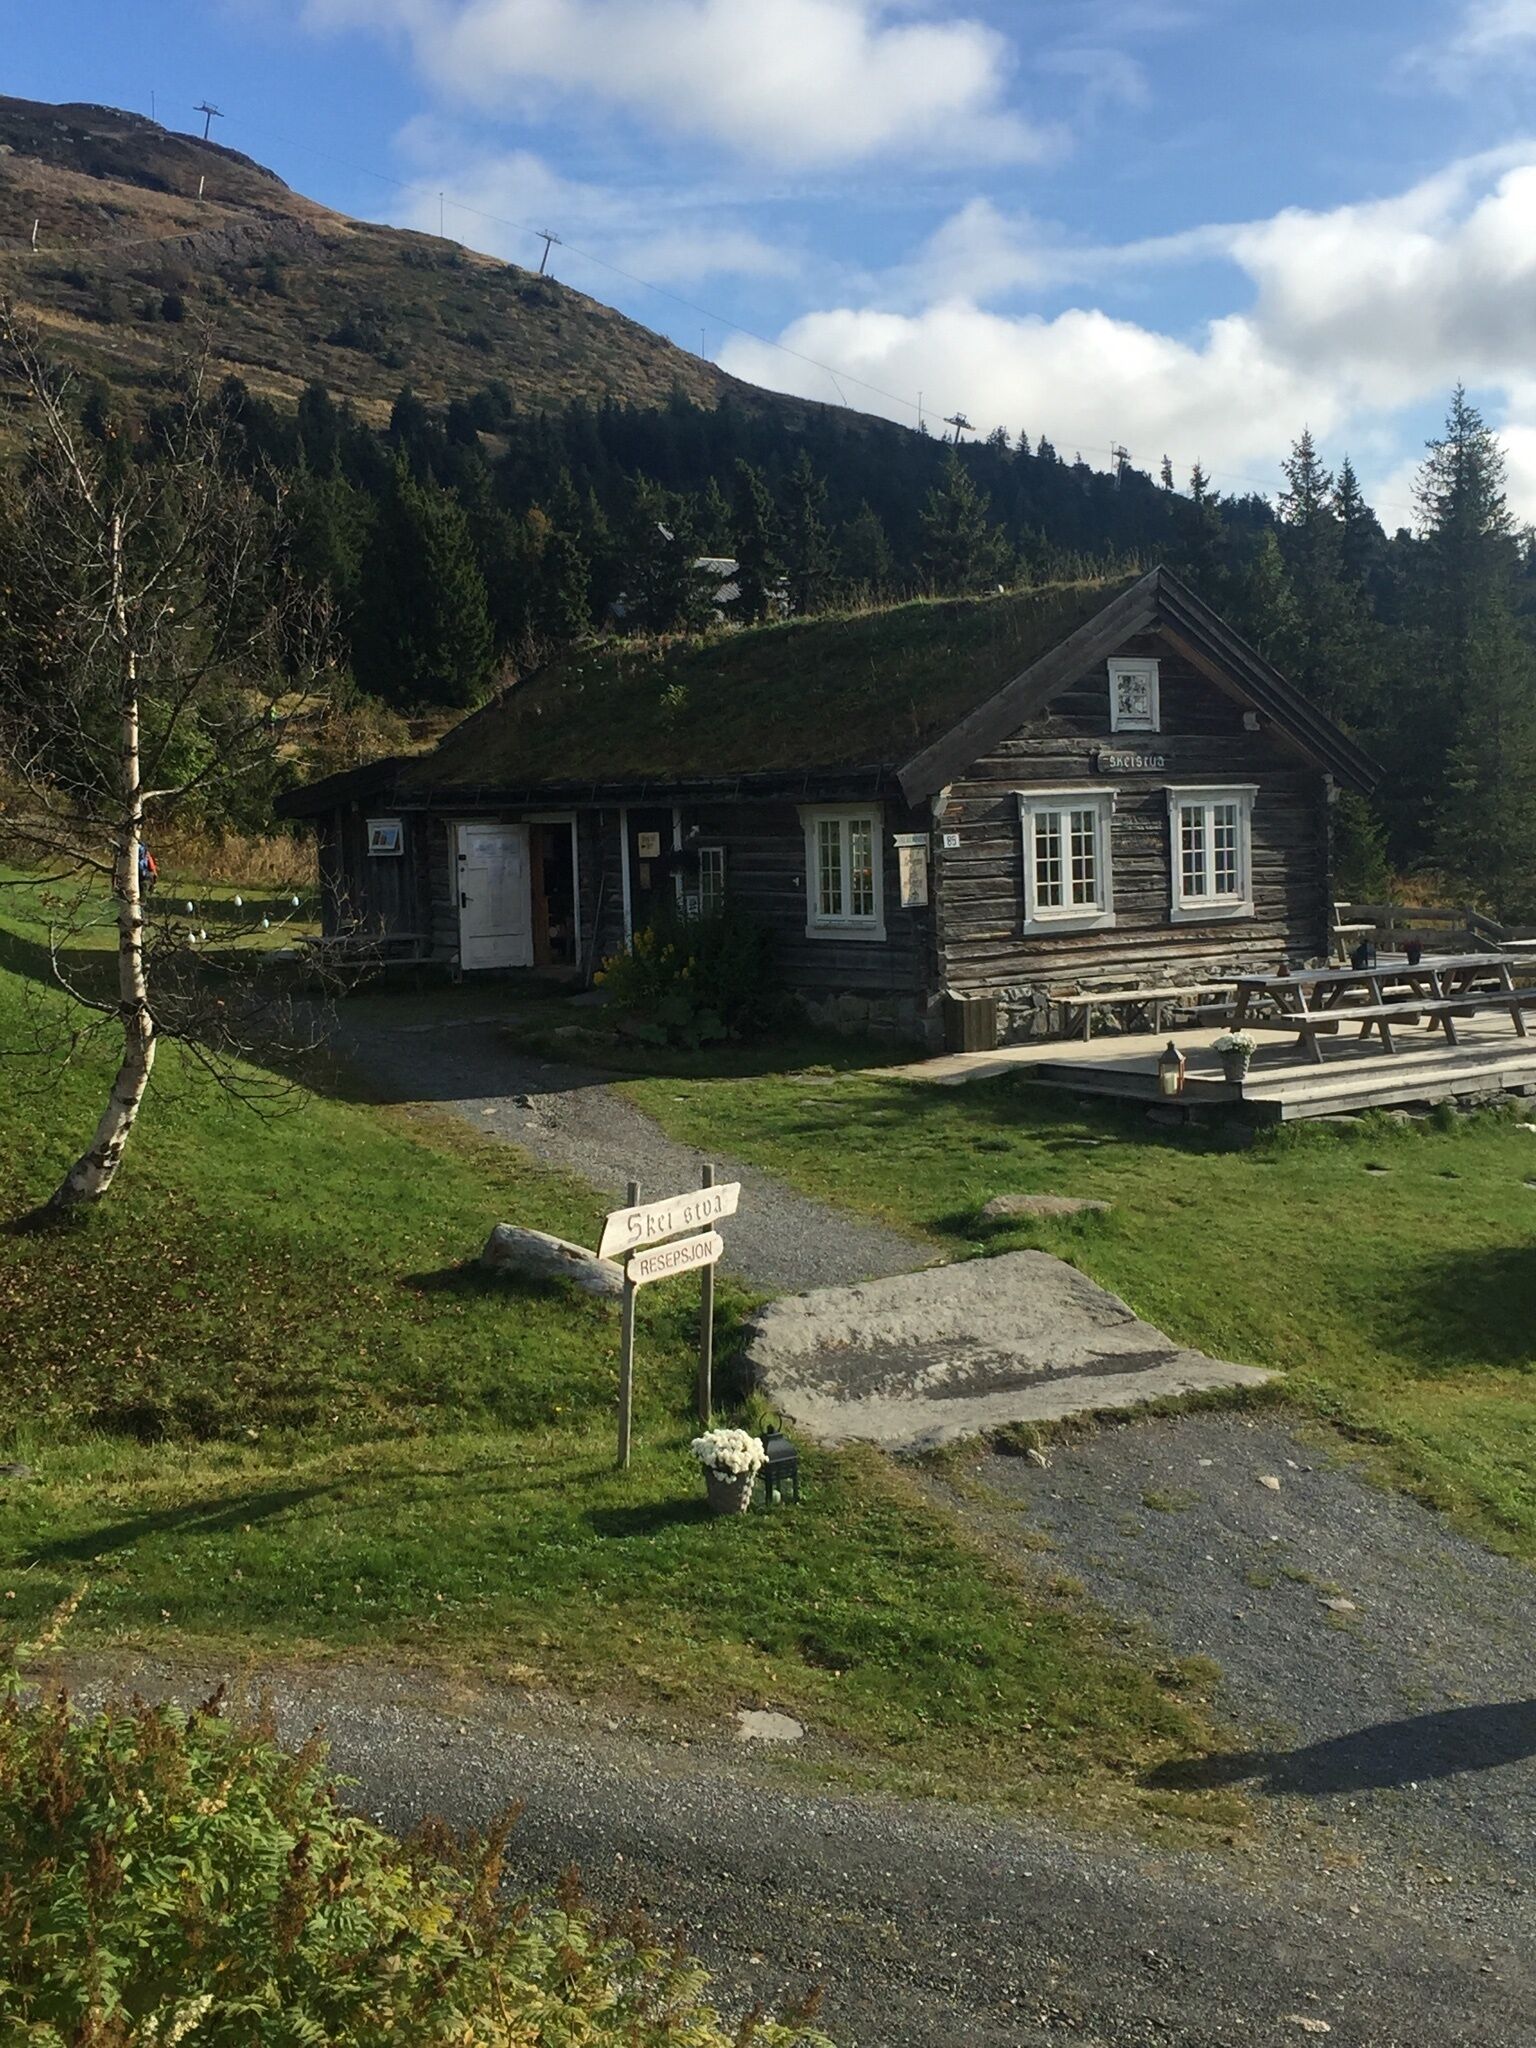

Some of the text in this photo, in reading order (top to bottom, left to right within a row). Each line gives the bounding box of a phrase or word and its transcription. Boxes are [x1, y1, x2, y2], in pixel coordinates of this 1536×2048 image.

[946, 835, 957, 846] 85
[627, 1211, 672, 1243] Skei
[640, 1240, 713, 1276] RESEPSJON
